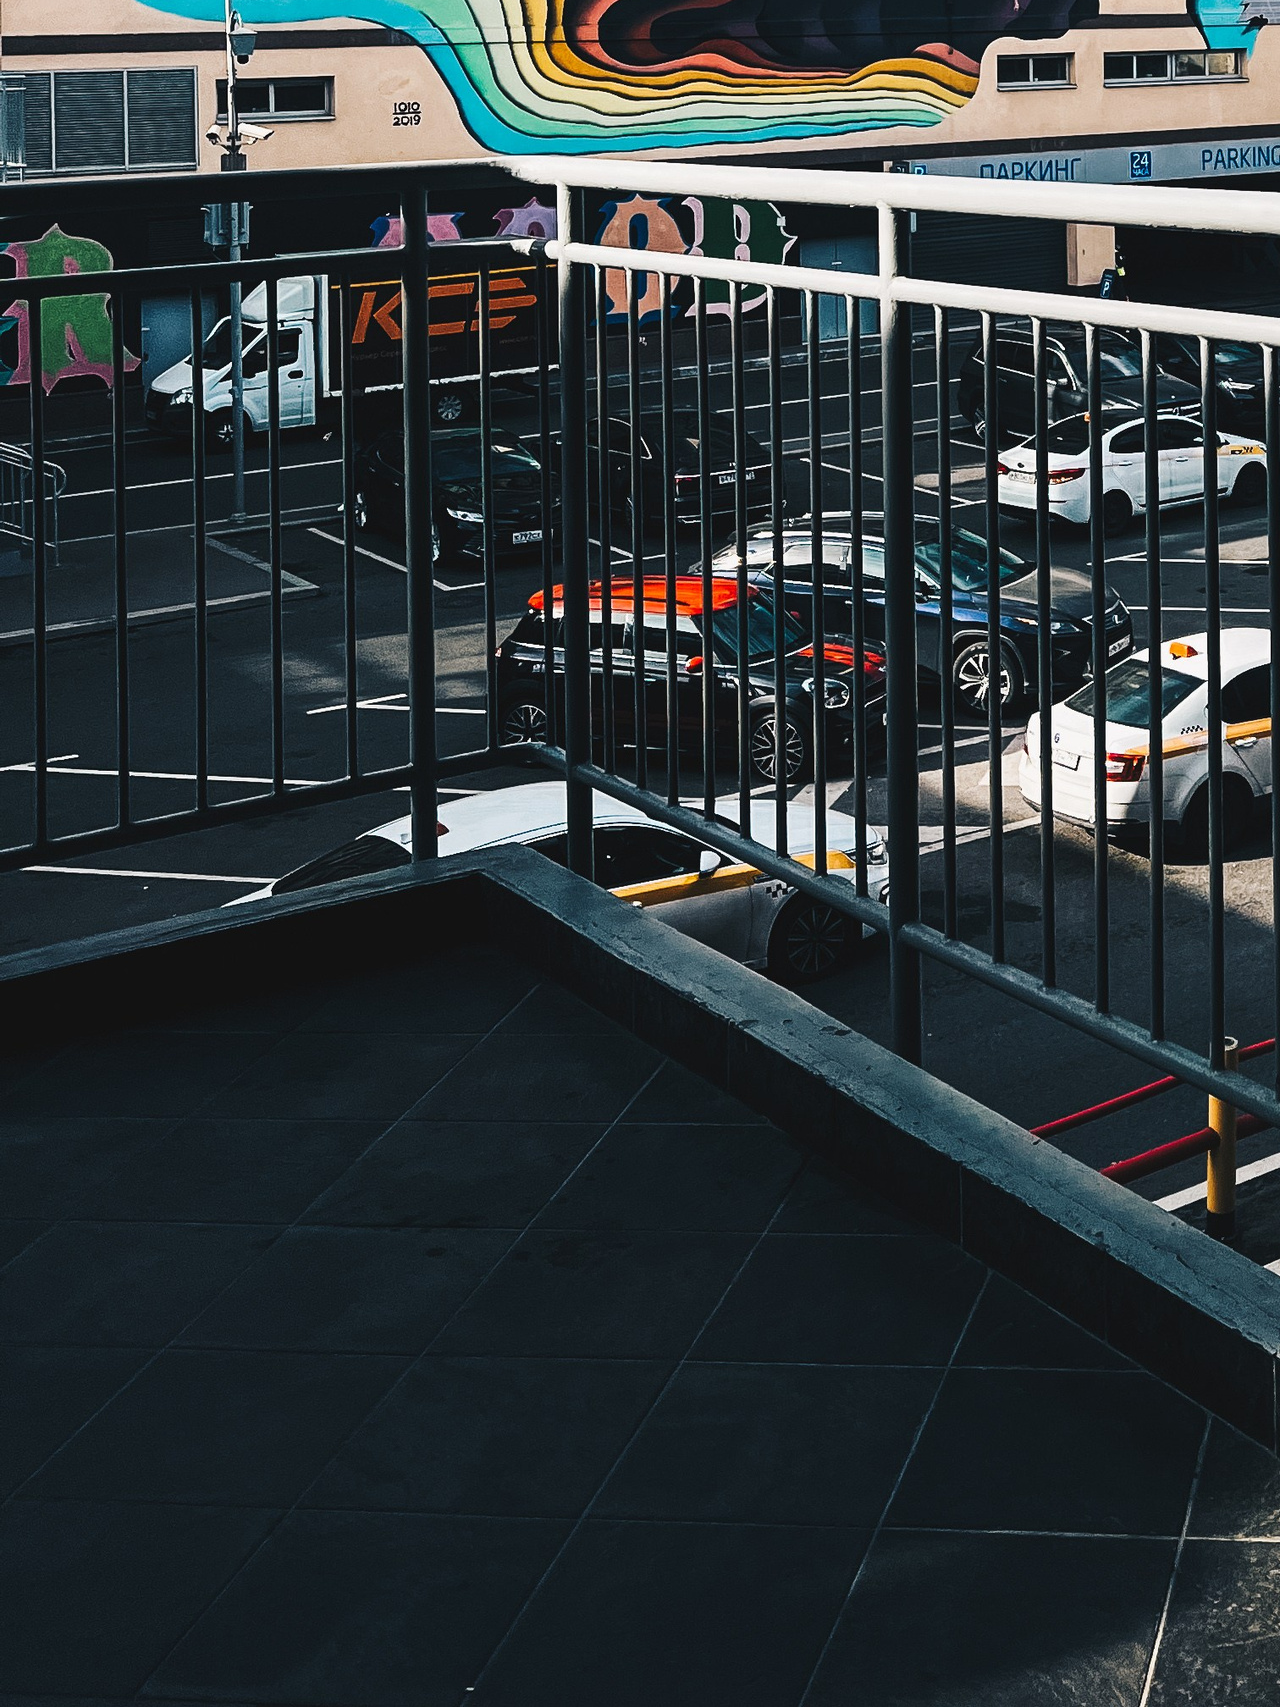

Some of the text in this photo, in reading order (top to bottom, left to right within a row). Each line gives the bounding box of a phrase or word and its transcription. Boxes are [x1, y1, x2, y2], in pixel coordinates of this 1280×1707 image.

[393, 101, 421, 113] 1010
[392, 114, 422, 127] 2019
[1132, 153, 1150, 169] 24
[1132, 168, 1150, 177] ЧАСА
